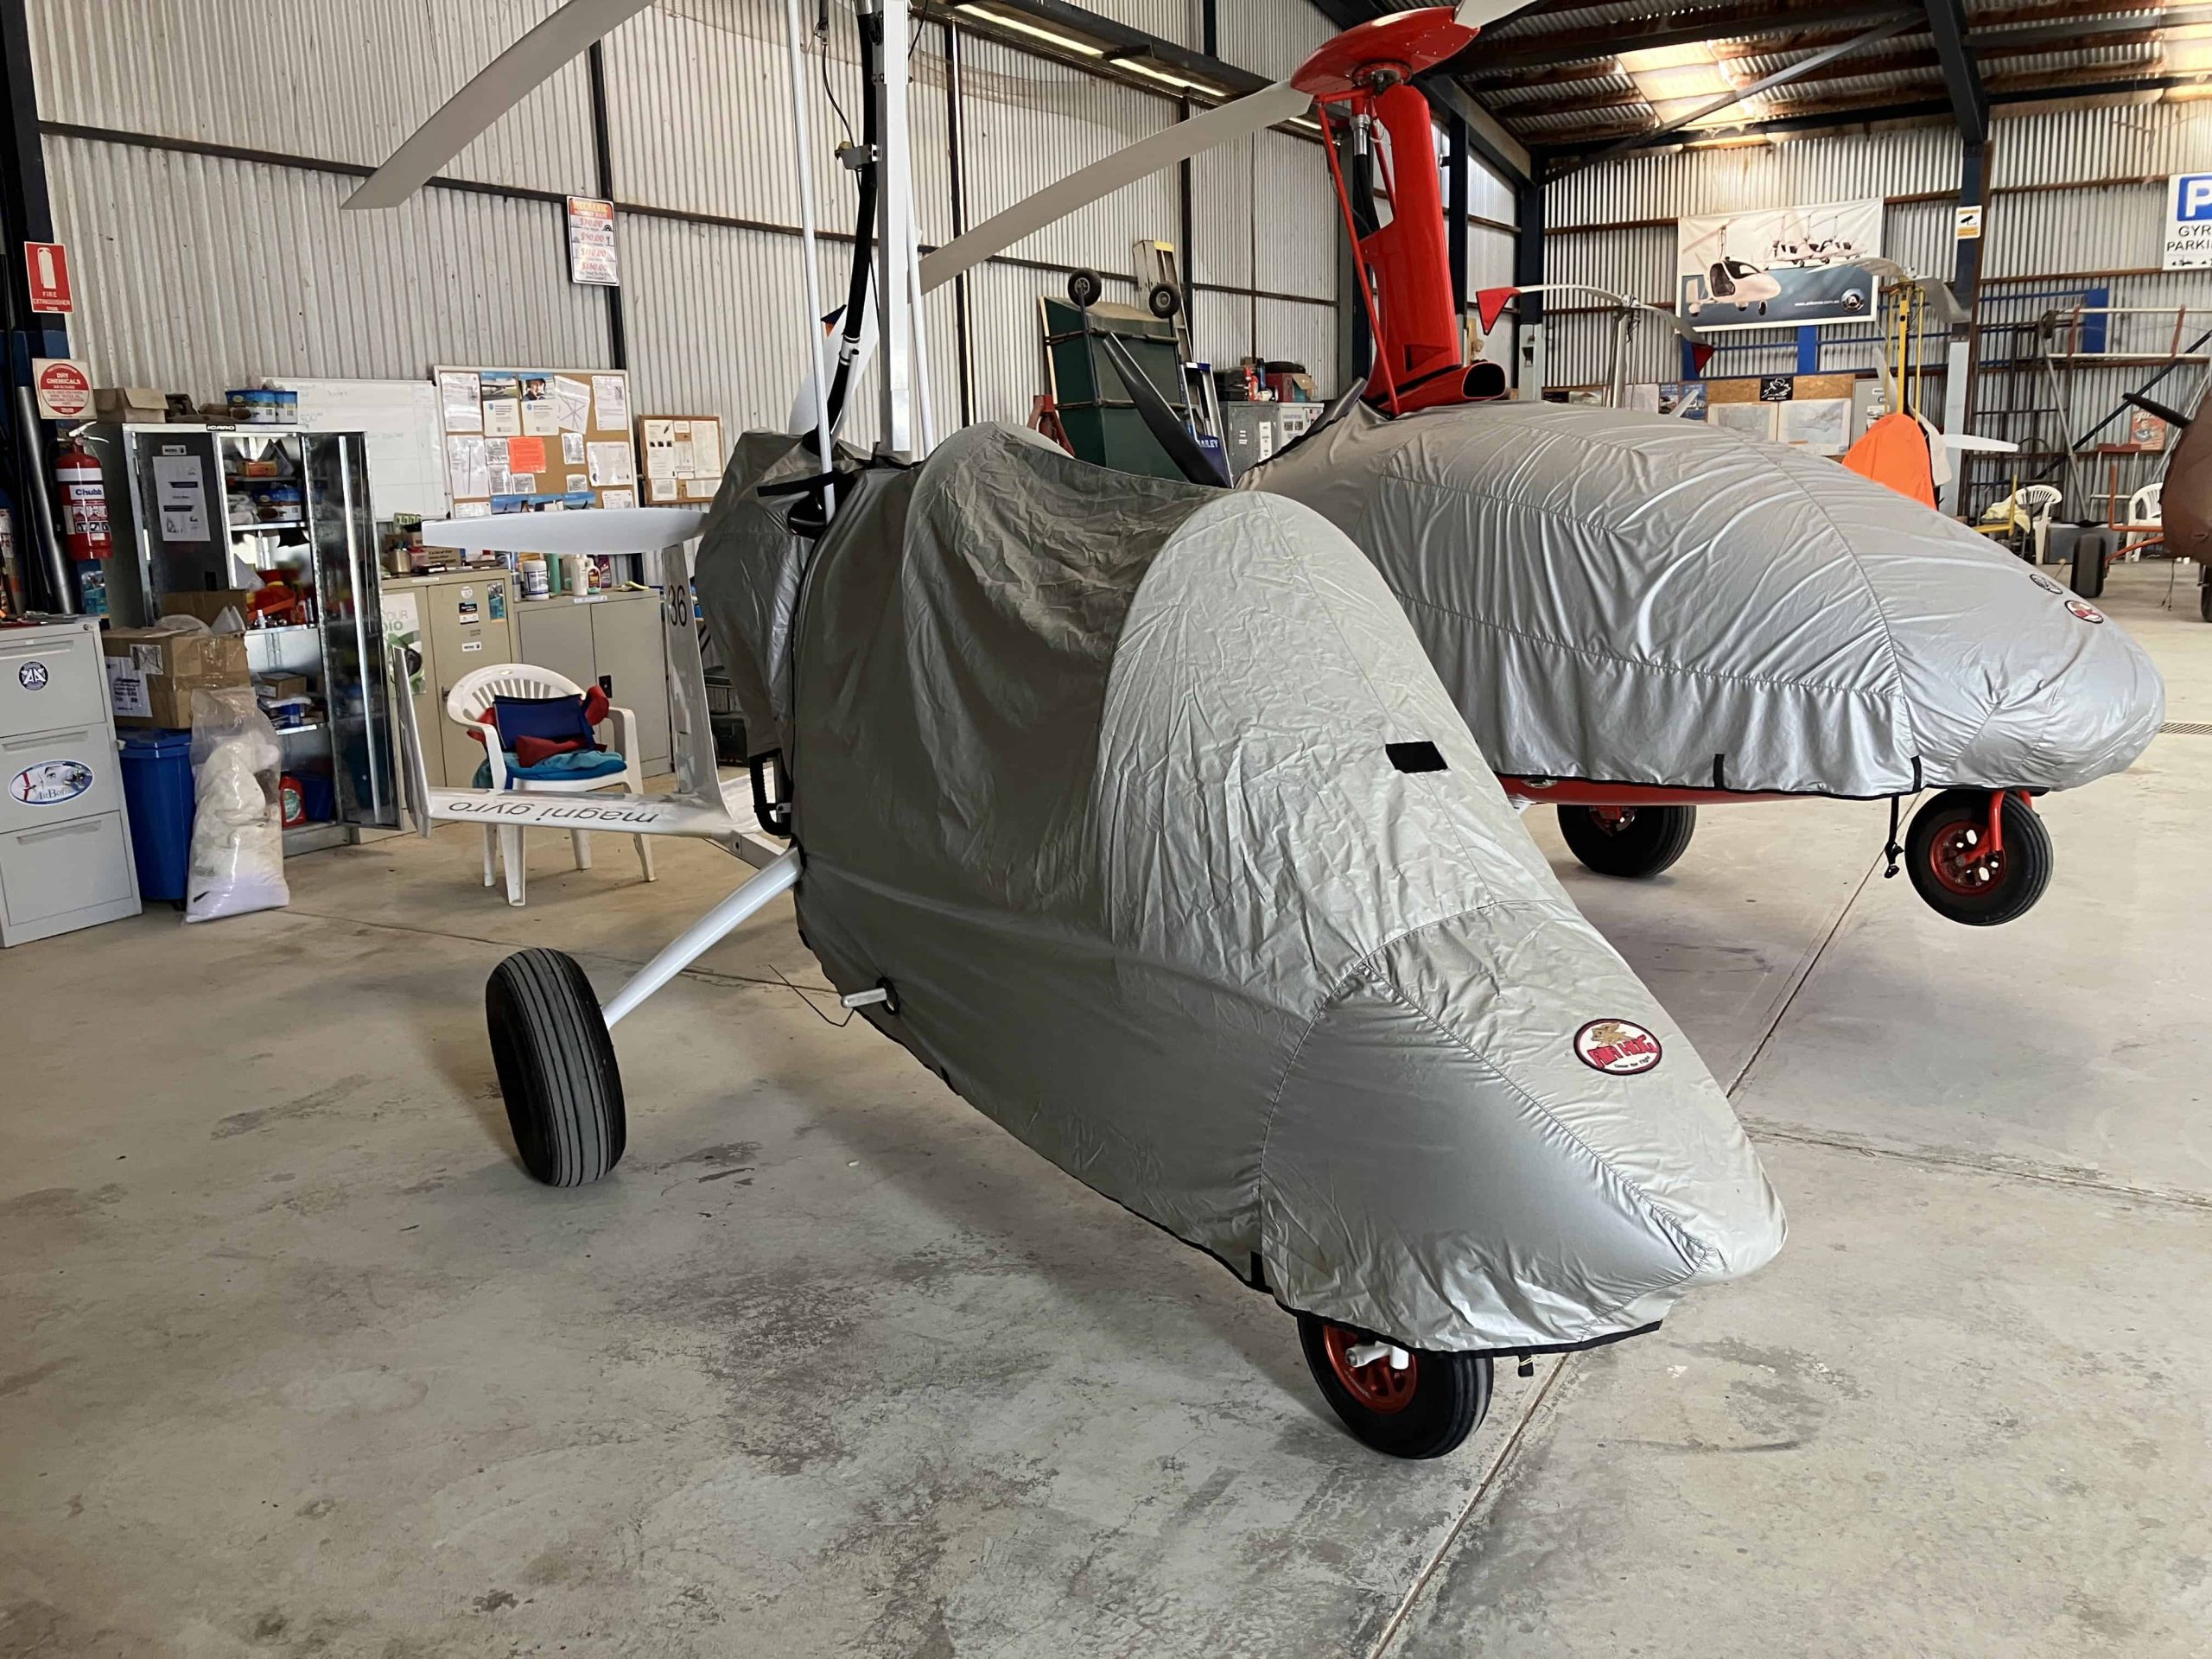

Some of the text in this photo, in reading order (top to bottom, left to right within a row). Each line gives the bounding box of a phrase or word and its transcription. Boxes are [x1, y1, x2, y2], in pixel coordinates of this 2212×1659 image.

[2185, 180, 2212, 218] P
[2166, 240, 2212, 251] PARKI
[448, 801, 659, 823] magni gyro
